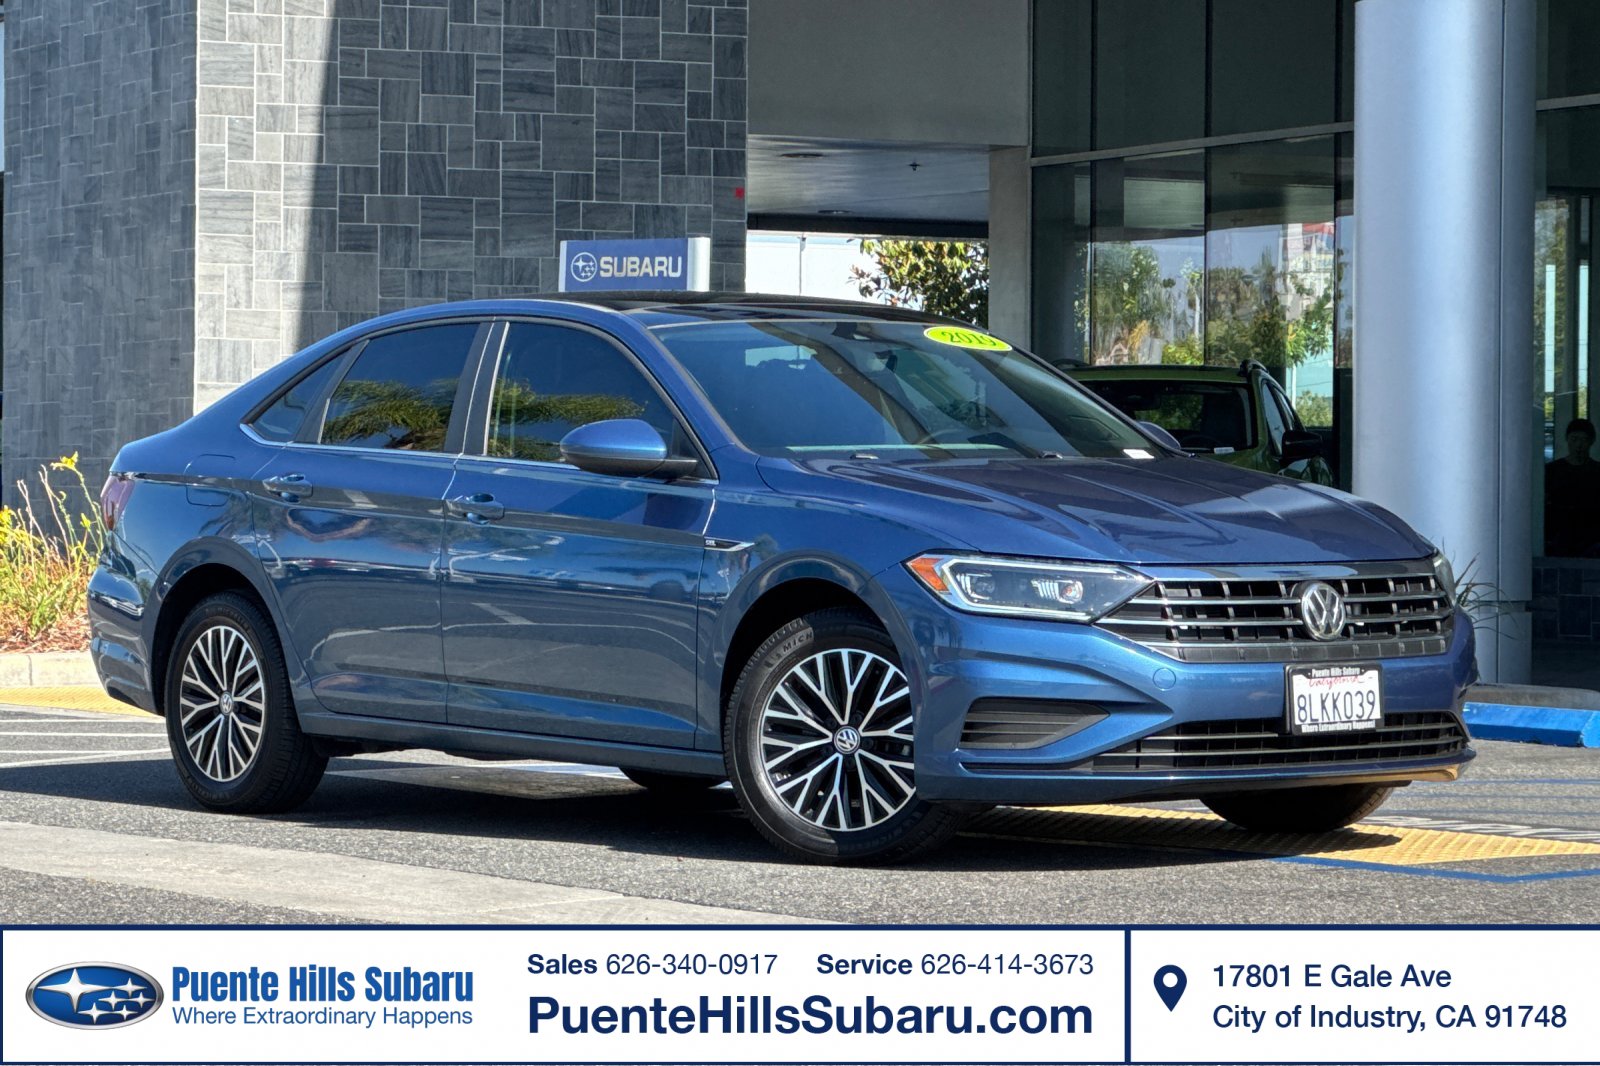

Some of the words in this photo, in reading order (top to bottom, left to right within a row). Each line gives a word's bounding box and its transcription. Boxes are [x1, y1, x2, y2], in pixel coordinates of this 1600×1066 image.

[600, 256, 682, 278] SUBARU
[941, 331, 996, 347] 2019
[1311, 668, 1330, 678] Puente
[1330, 667, 1342, 677] Hills
[1342, 666, 1361, 676] Subaru
[1297, 690, 1376, 723] 8LKK039
